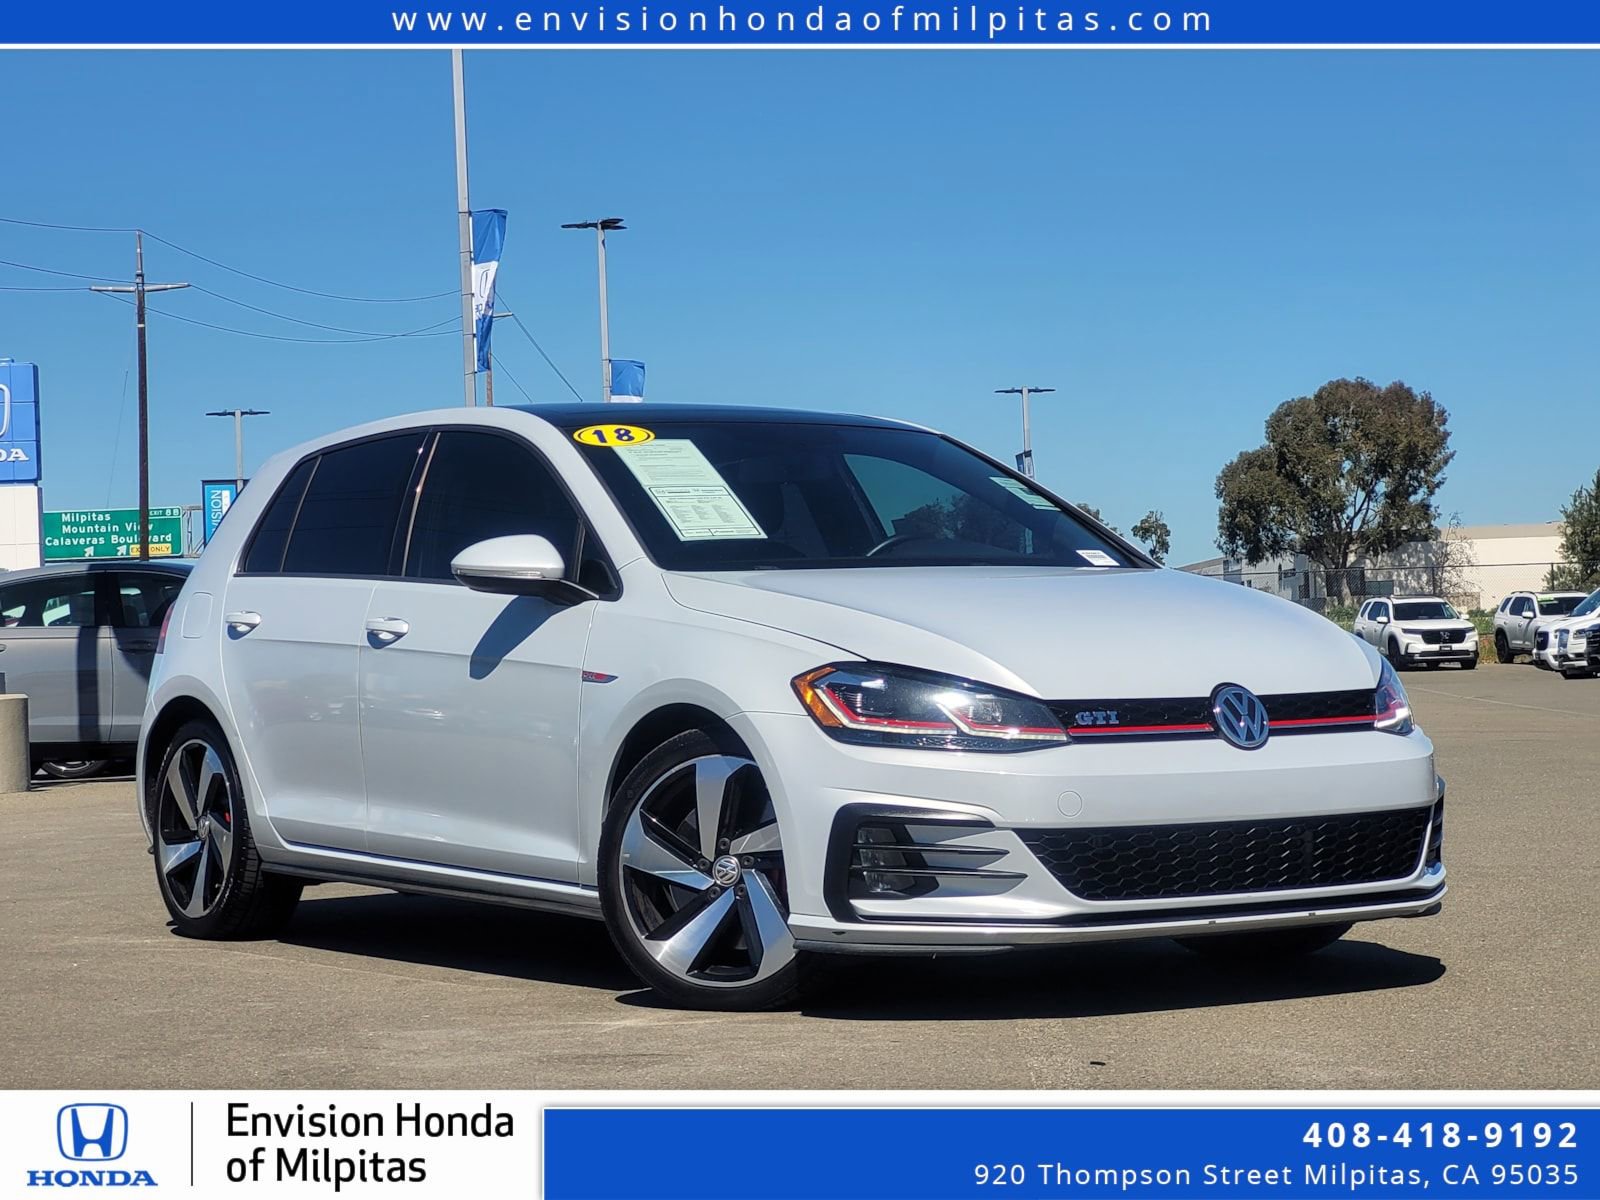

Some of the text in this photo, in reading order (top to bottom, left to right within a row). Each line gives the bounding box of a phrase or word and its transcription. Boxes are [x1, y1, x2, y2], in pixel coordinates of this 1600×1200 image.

[592, 427, 635, 443] 18
[61, 512, 111, 524] Milpitas
[62, 522, 153, 534] Mountain Vi
[45, 533, 172, 546] Calaveras Boulard
[1075, 710, 1120, 726] GTI
